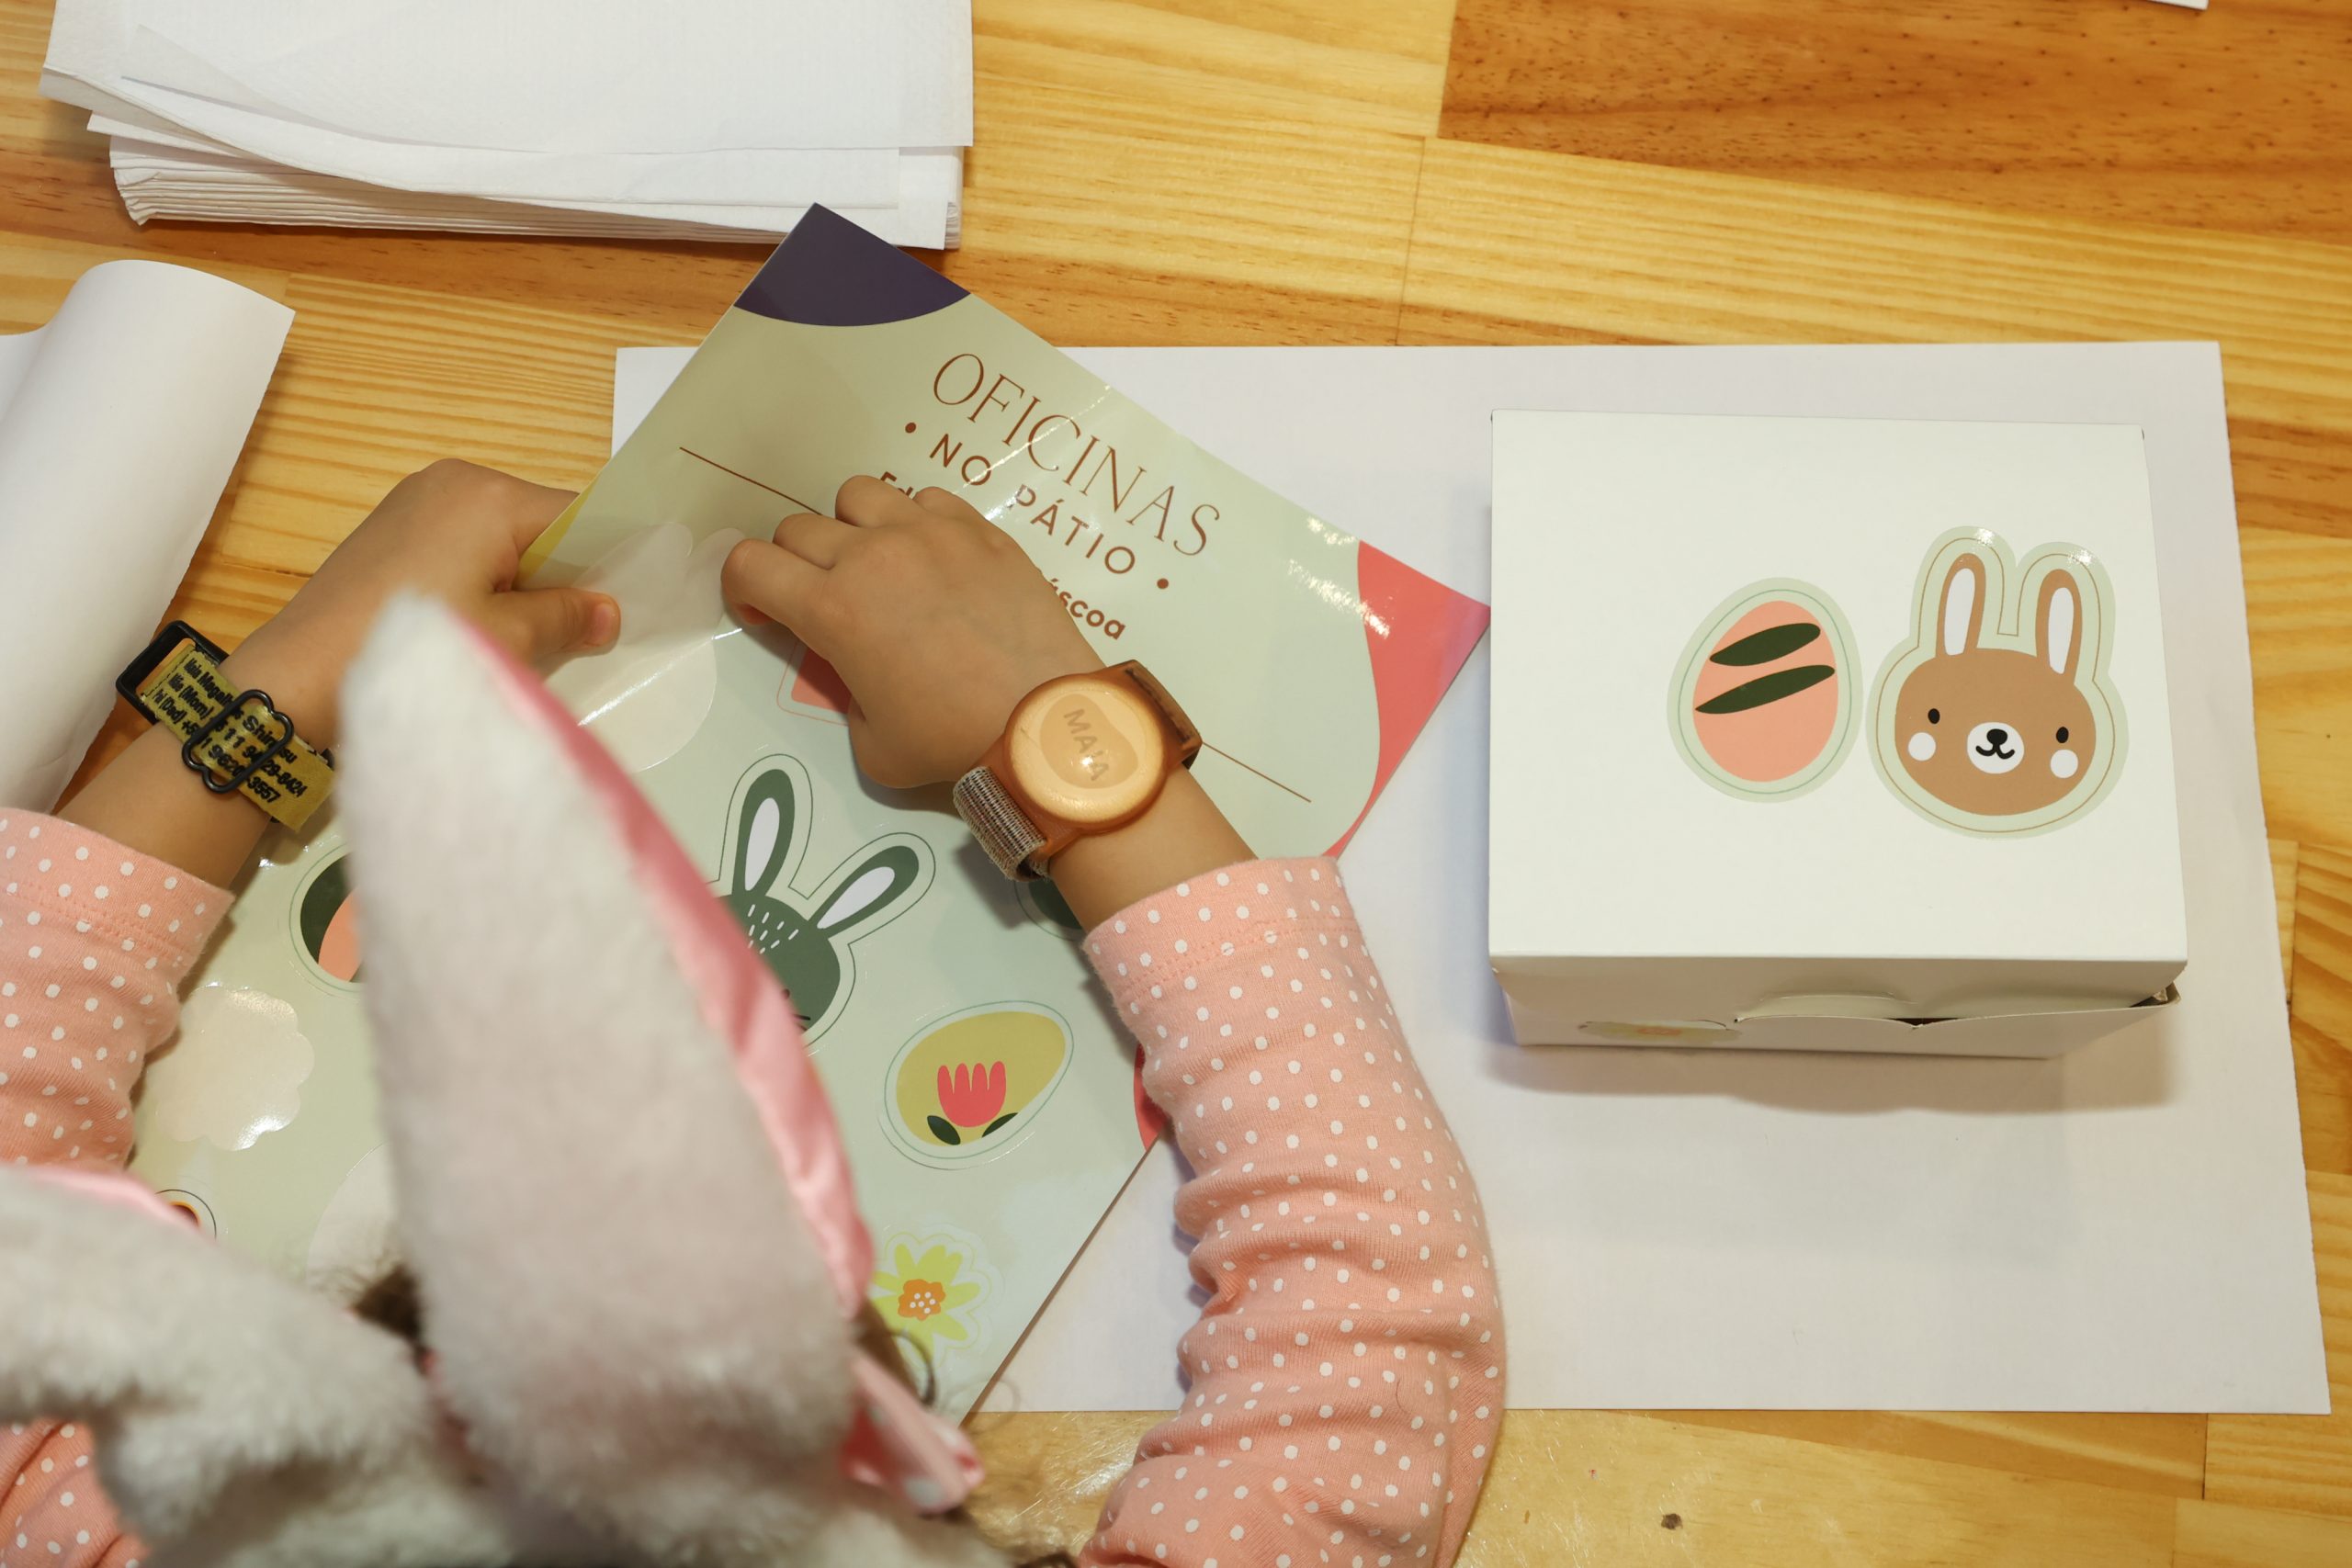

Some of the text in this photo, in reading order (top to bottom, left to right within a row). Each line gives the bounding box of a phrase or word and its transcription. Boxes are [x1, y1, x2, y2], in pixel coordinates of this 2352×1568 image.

[930, 433, 1136, 574] NO PÁTIO
[933, 354, 1220, 556] OFICINAS
[1050, 577, 1126, 640] scoa
[1064, 708, 1109, 780] MAIA
